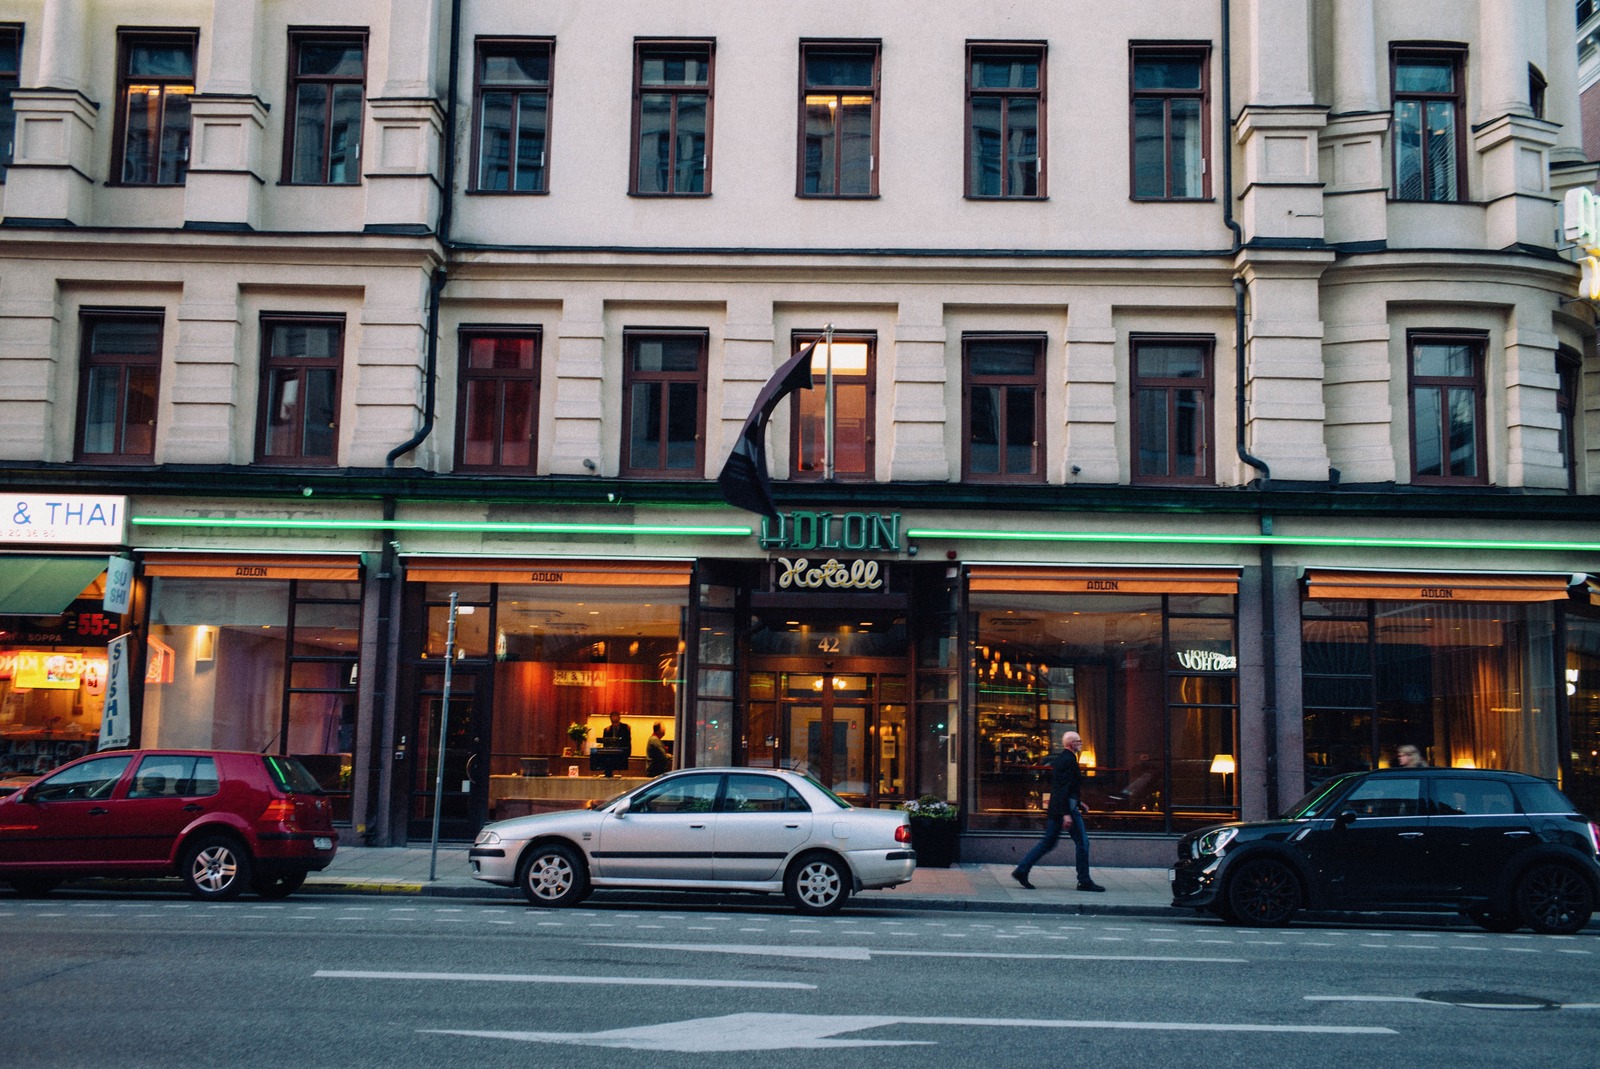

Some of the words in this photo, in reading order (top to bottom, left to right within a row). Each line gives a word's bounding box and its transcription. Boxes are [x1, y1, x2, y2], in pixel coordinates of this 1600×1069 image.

[13, 501, 32, 525] &
[45, 502, 117, 526] THAI
[759, 510, 901, 551] ADLON
[235, 566, 267, 577] ADLON
[531, 571, 563, 582] ADLON
[777, 556, 883, 590] Hotell
[1086, 580, 1119, 591] ADLON
[1420, 587, 1454, 599] ADLON
[78, 613, 117, 636] 55:-
[27, 633, 62, 643] SOPPA
[817, 637, 840, 653] 42
[106, 642, 122, 737] SUSHI
